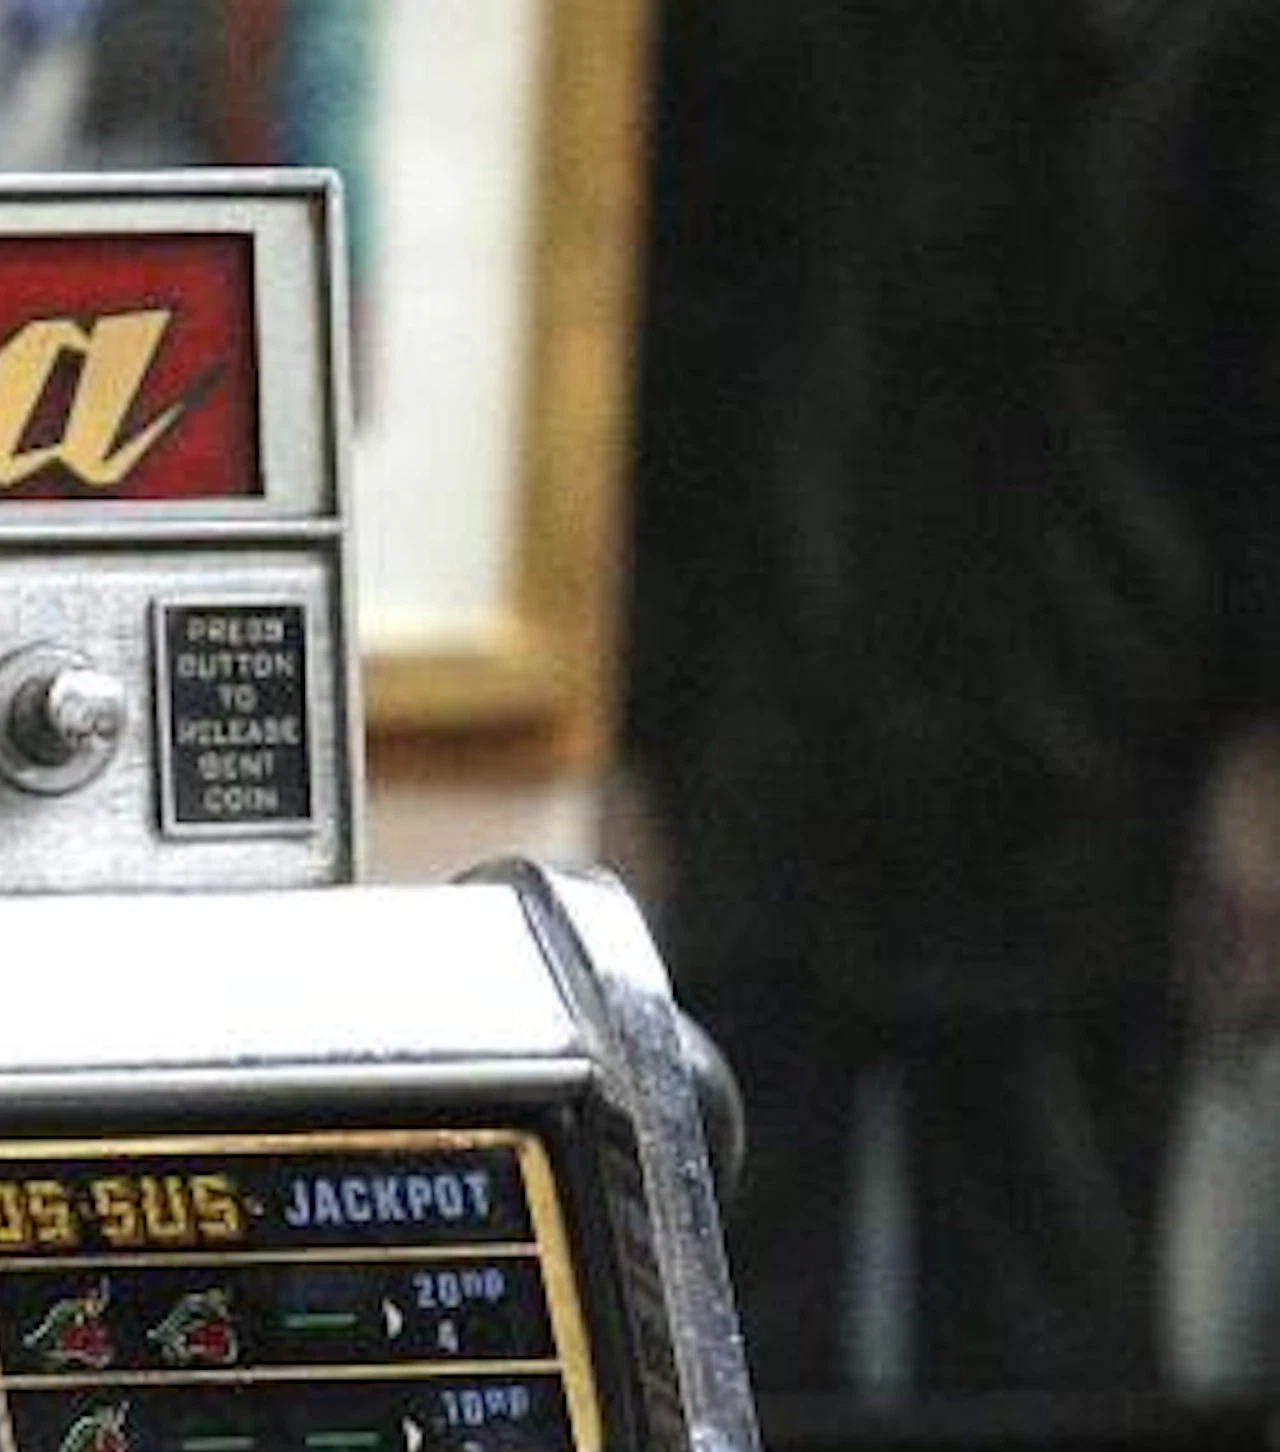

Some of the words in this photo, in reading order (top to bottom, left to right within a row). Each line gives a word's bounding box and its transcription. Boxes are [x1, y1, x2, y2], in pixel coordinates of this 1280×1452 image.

[186, 615, 284, 646] PRESS
[176, 652, 295, 679] BUTTON
[218, 683, 258, 712] TO
[176, 717, 301, 746] RELEASE
[197, 750, 275, 781] BENT
[203, 785, 280, 814] COIN
[285, 1170, 489, 1228] JACKPOT
